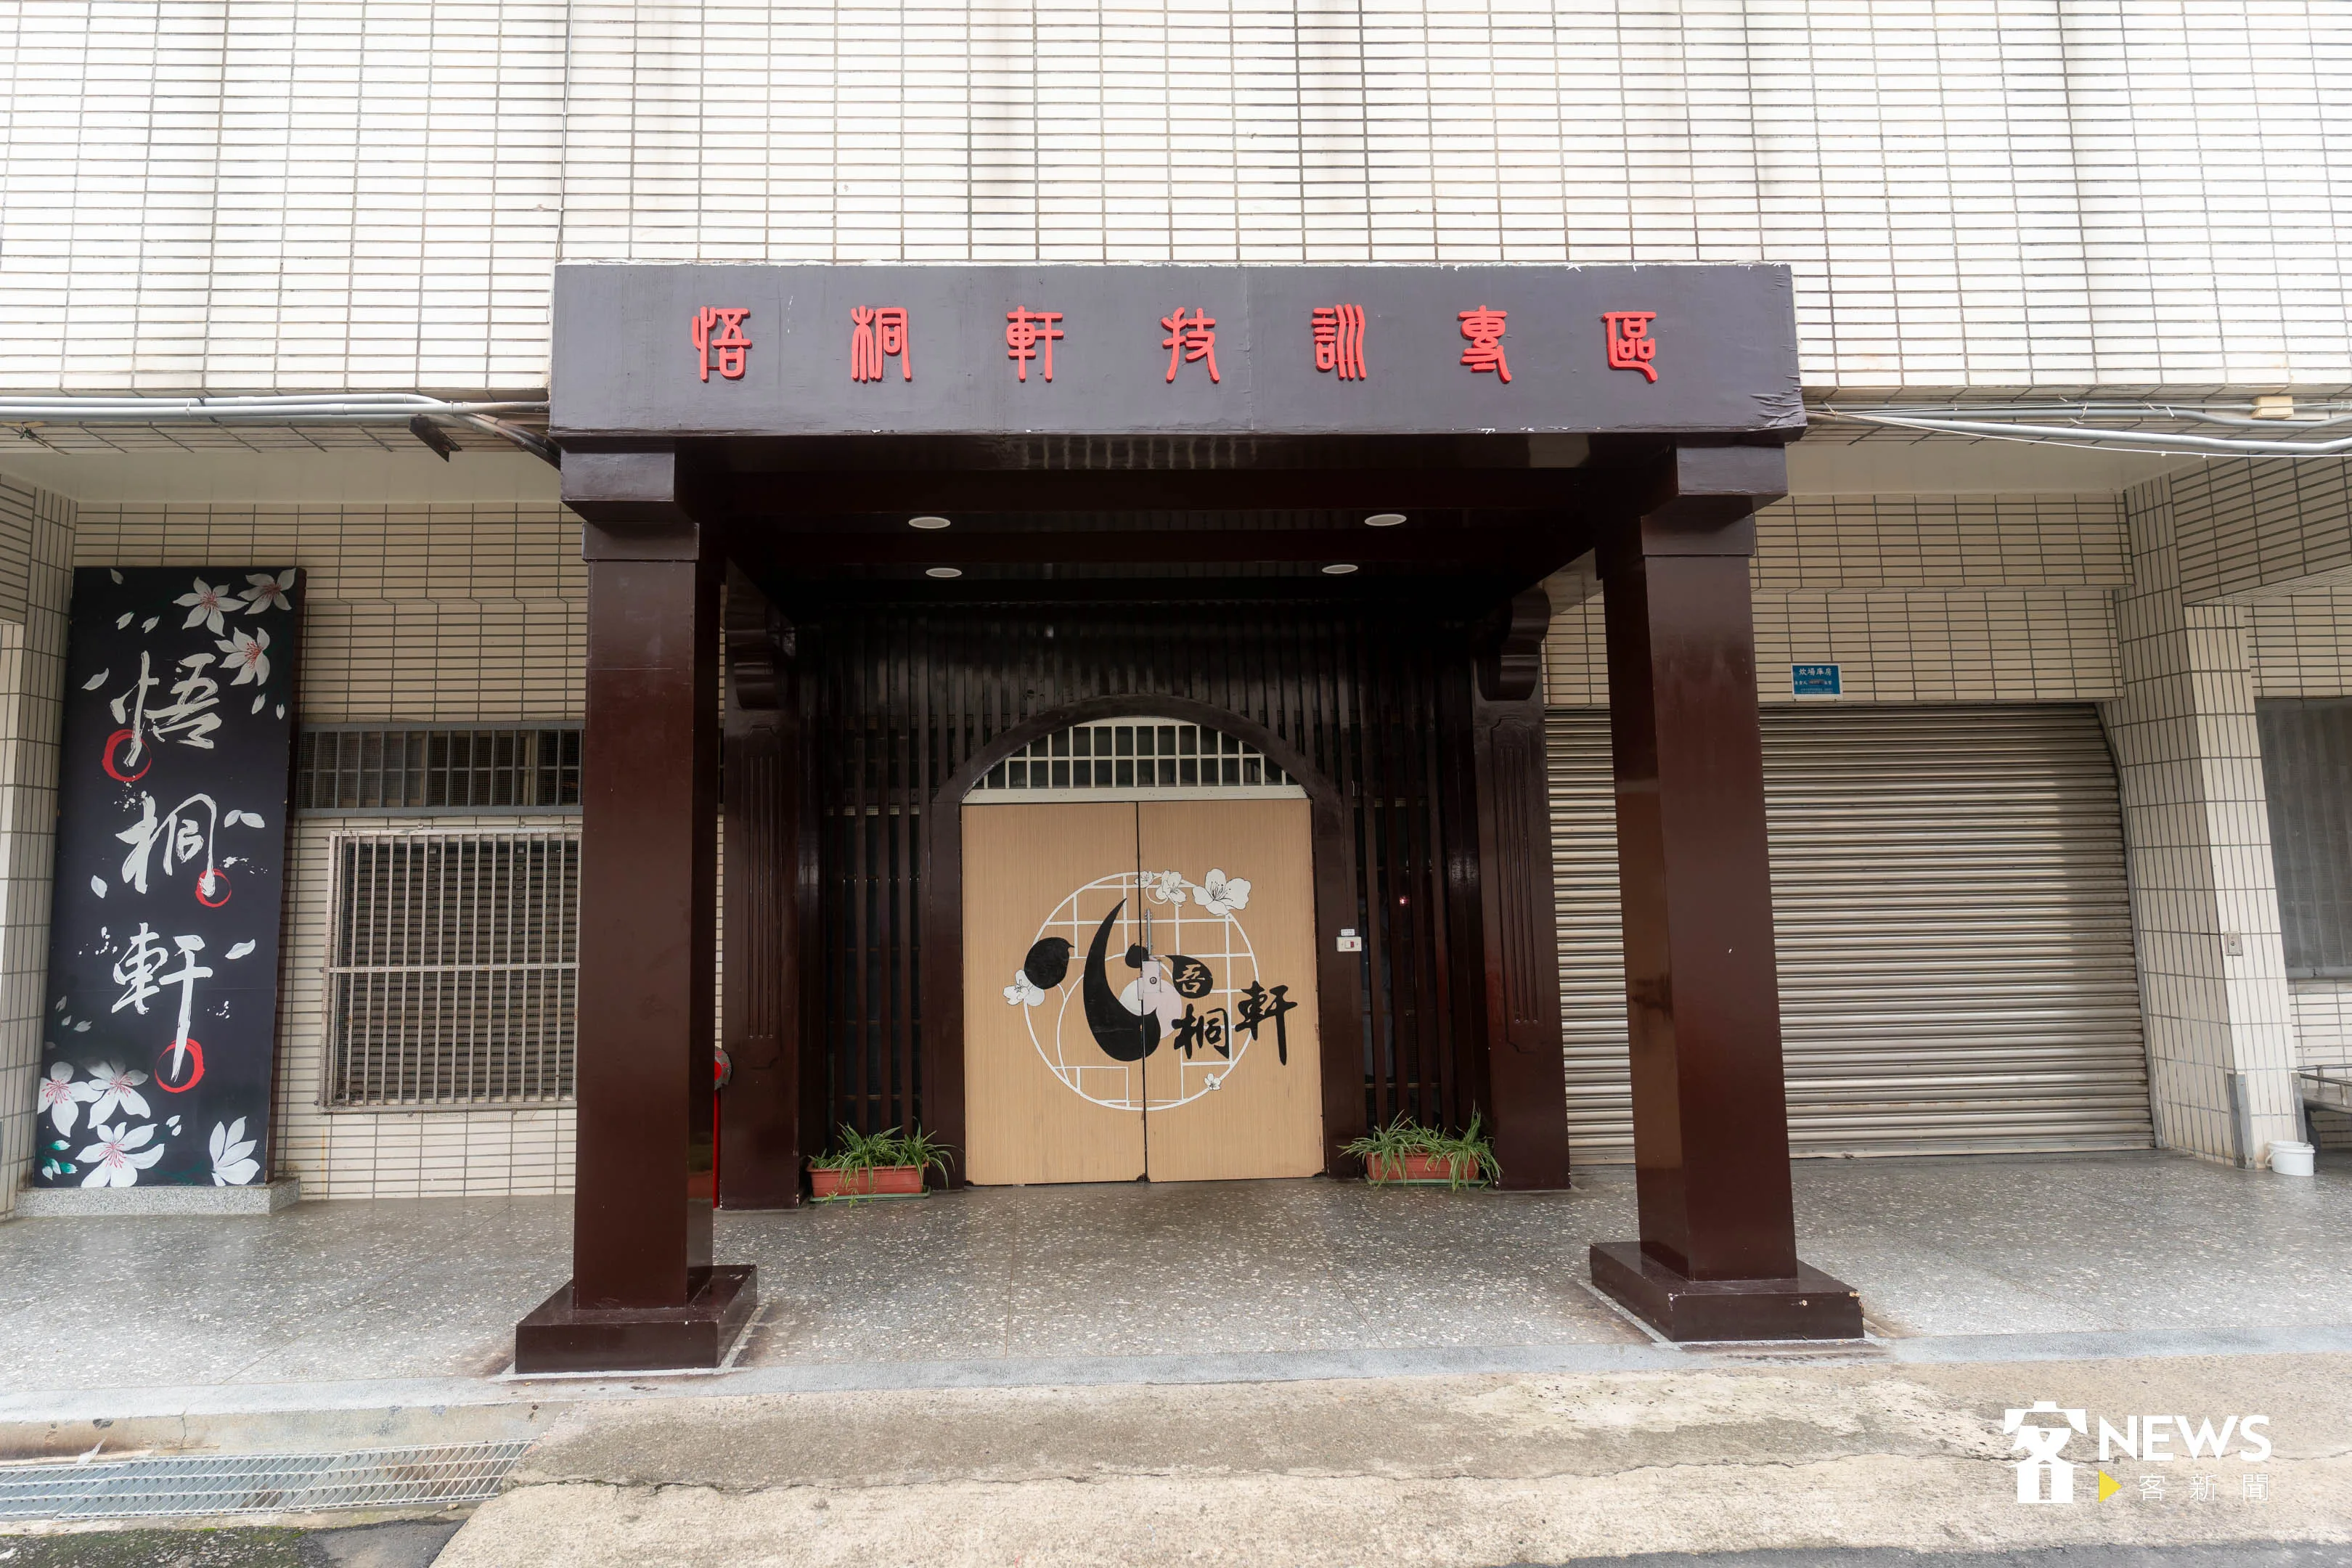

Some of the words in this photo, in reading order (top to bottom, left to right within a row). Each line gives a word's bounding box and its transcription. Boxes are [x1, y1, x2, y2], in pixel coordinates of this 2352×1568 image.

[691, 305, 1658, 383] 悟桐軒技訓專區
[110, 650, 223, 1082] 悟桐軒
